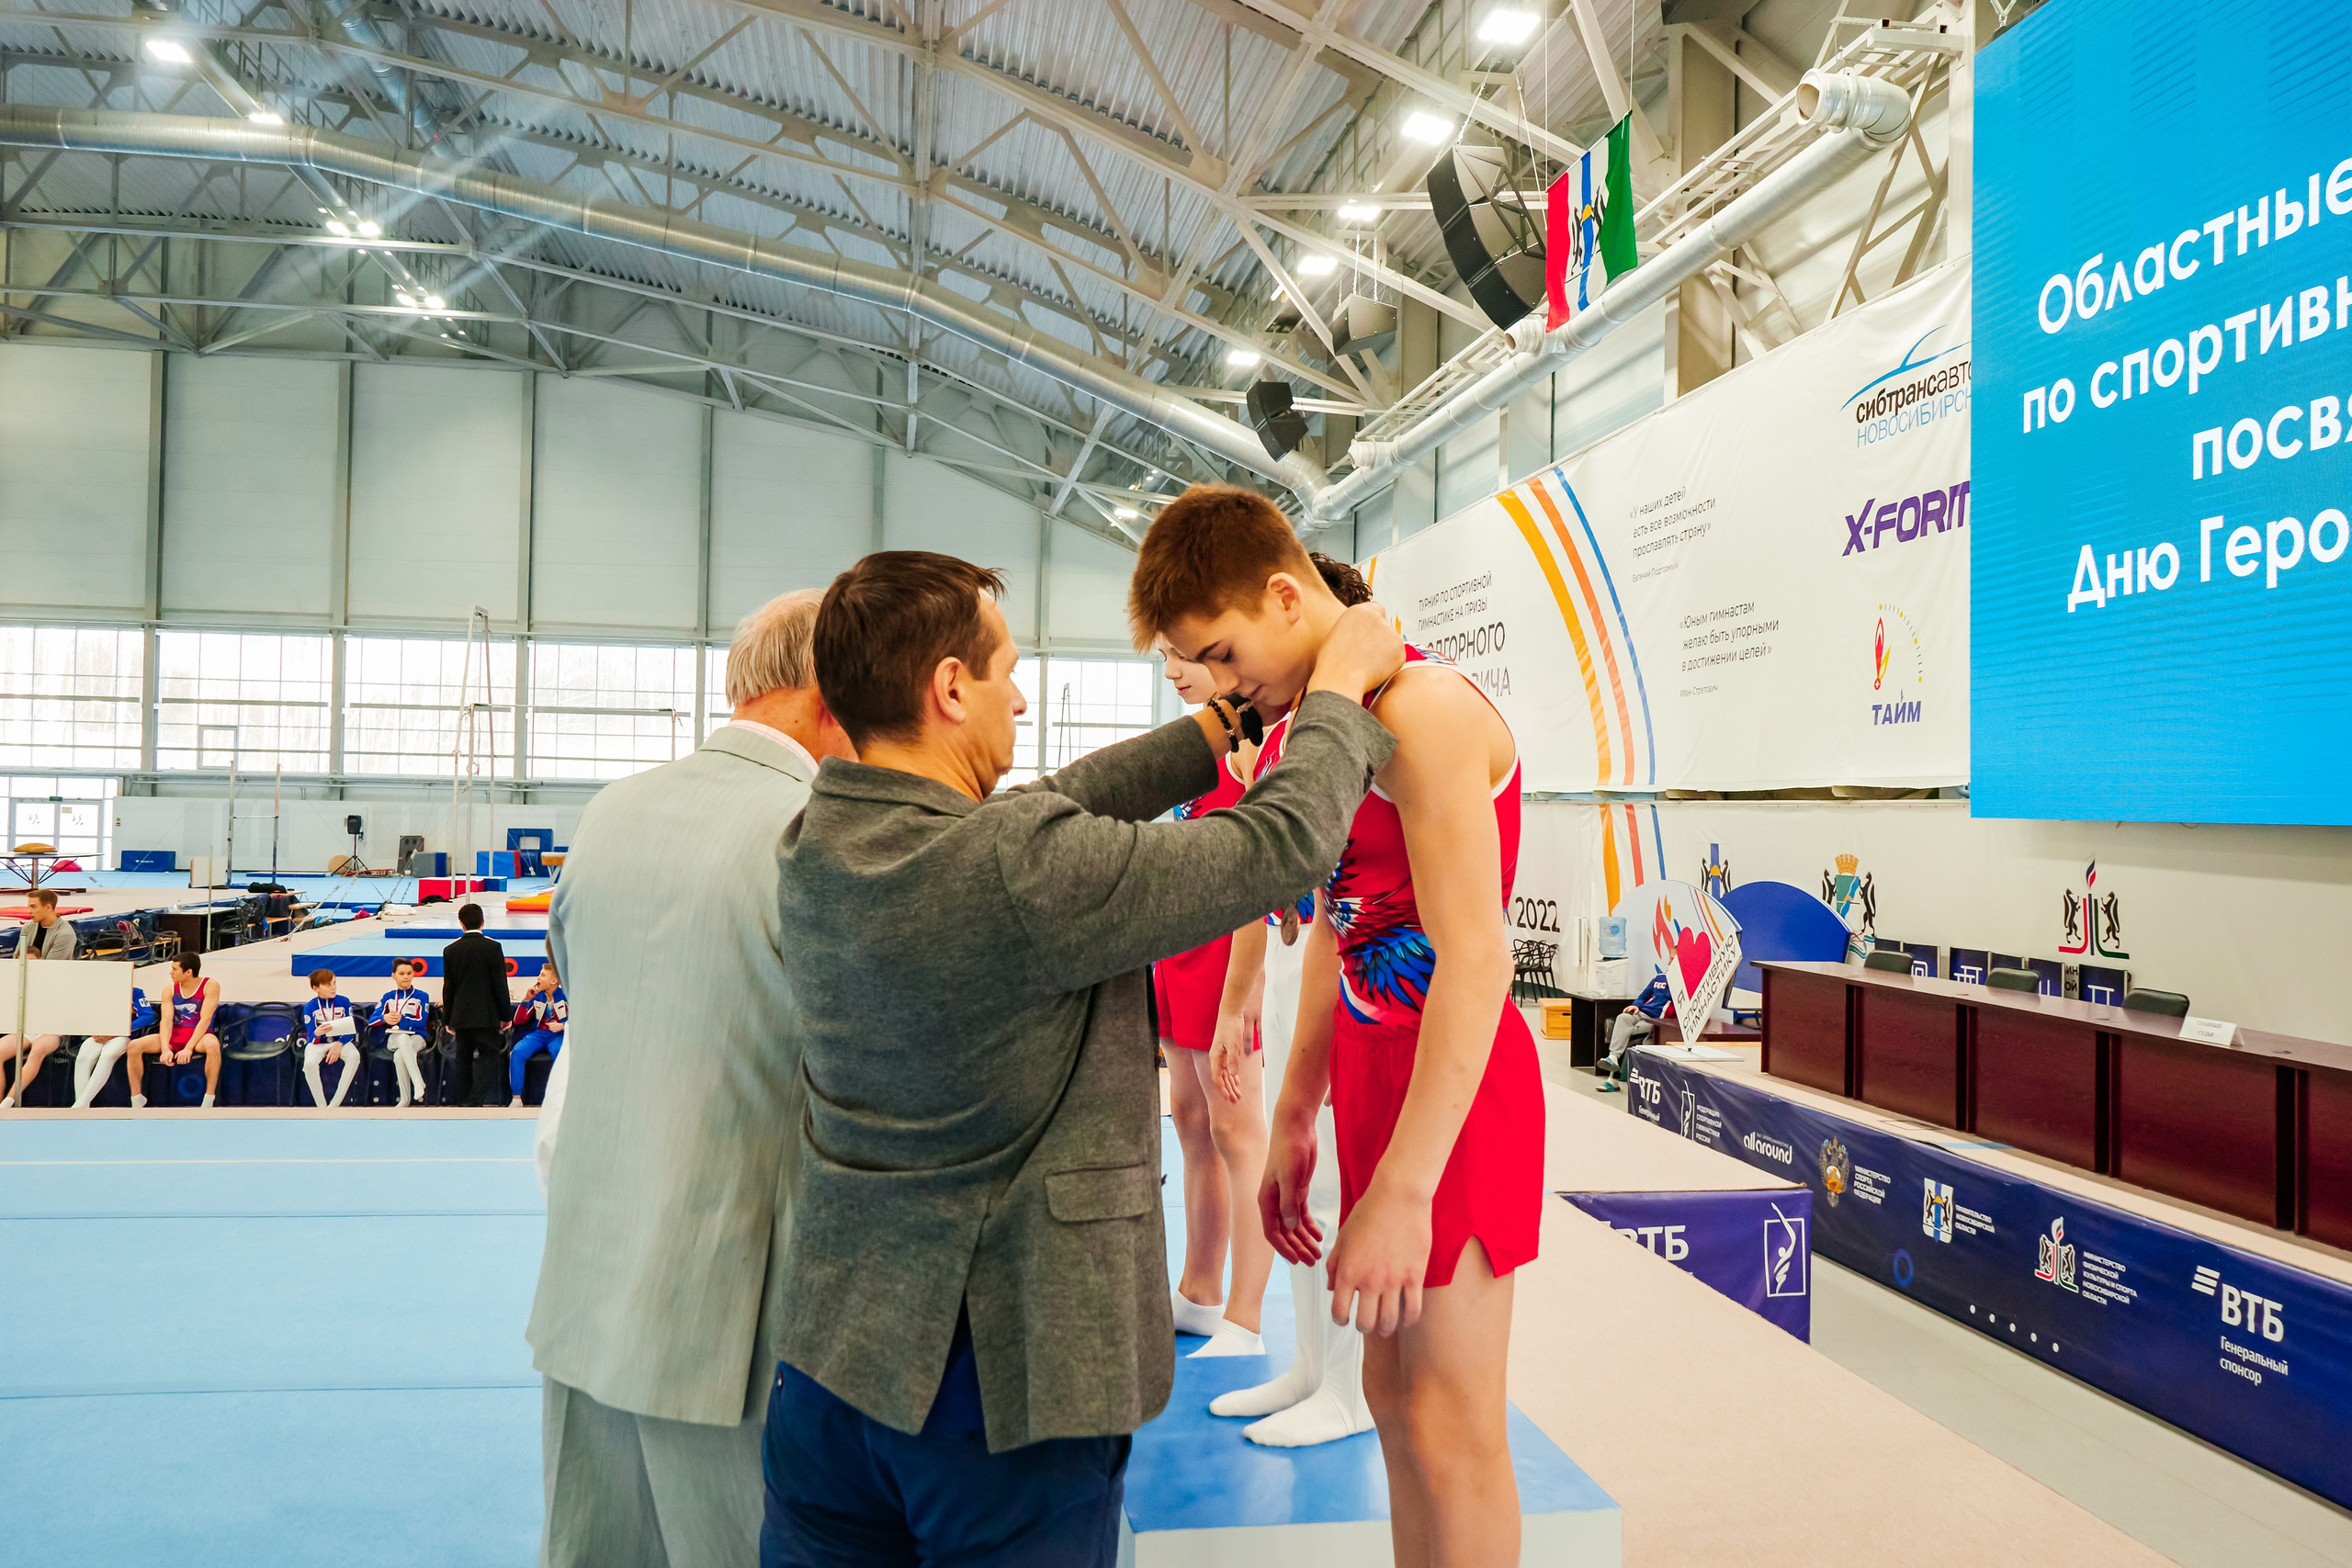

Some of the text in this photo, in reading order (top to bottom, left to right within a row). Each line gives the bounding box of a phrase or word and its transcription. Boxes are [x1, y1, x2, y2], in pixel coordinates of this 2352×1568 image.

[2038, 157, 2352, 334] Областные
[2023, 382, 2075, 434] по
[2192, 393, 2352, 480] посв
[1634, 498, 1716, 538] есть все возможности
[1639, 499, 1663, 516] наших
[1664, 486, 1687, 508] детей
[1633, 523, 1712, 559] прославлять страну»
[2067, 508, 2350, 613] Дню Геро
[1419, 570, 1492, 612] ТУРНИР ПО СПОРТИВНОЙ
[1419, 597, 1487, 632] ГИМНАСТИКЕ НА ПРИЗЫ
[1679, 602, 1755, 629] «Юным гимнастам
[1415, 622, 1505, 661] ГОРНОГО
[1682, 619, 1780, 650] желаю быть упорными
[1687, 651, 1737, 672] достижении
[1739, 642, 1772, 661] целей»
[1871, 689, 1921, 726] ТАЙМ
[1515, 897, 1560, 932] 2022
[1677, 989, 1686, 1009] Я
[1683, 934, 1734, 1029] СПОРТИВНУЮ
[1686, 944, 1736, 1041] ГИМНАСТИКУ
[2222, 1283, 2284, 1342] ВТБ
[2220, 1358, 2262, 1386] спонсор
[2221, 1335, 2289, 1376] Генеральный
